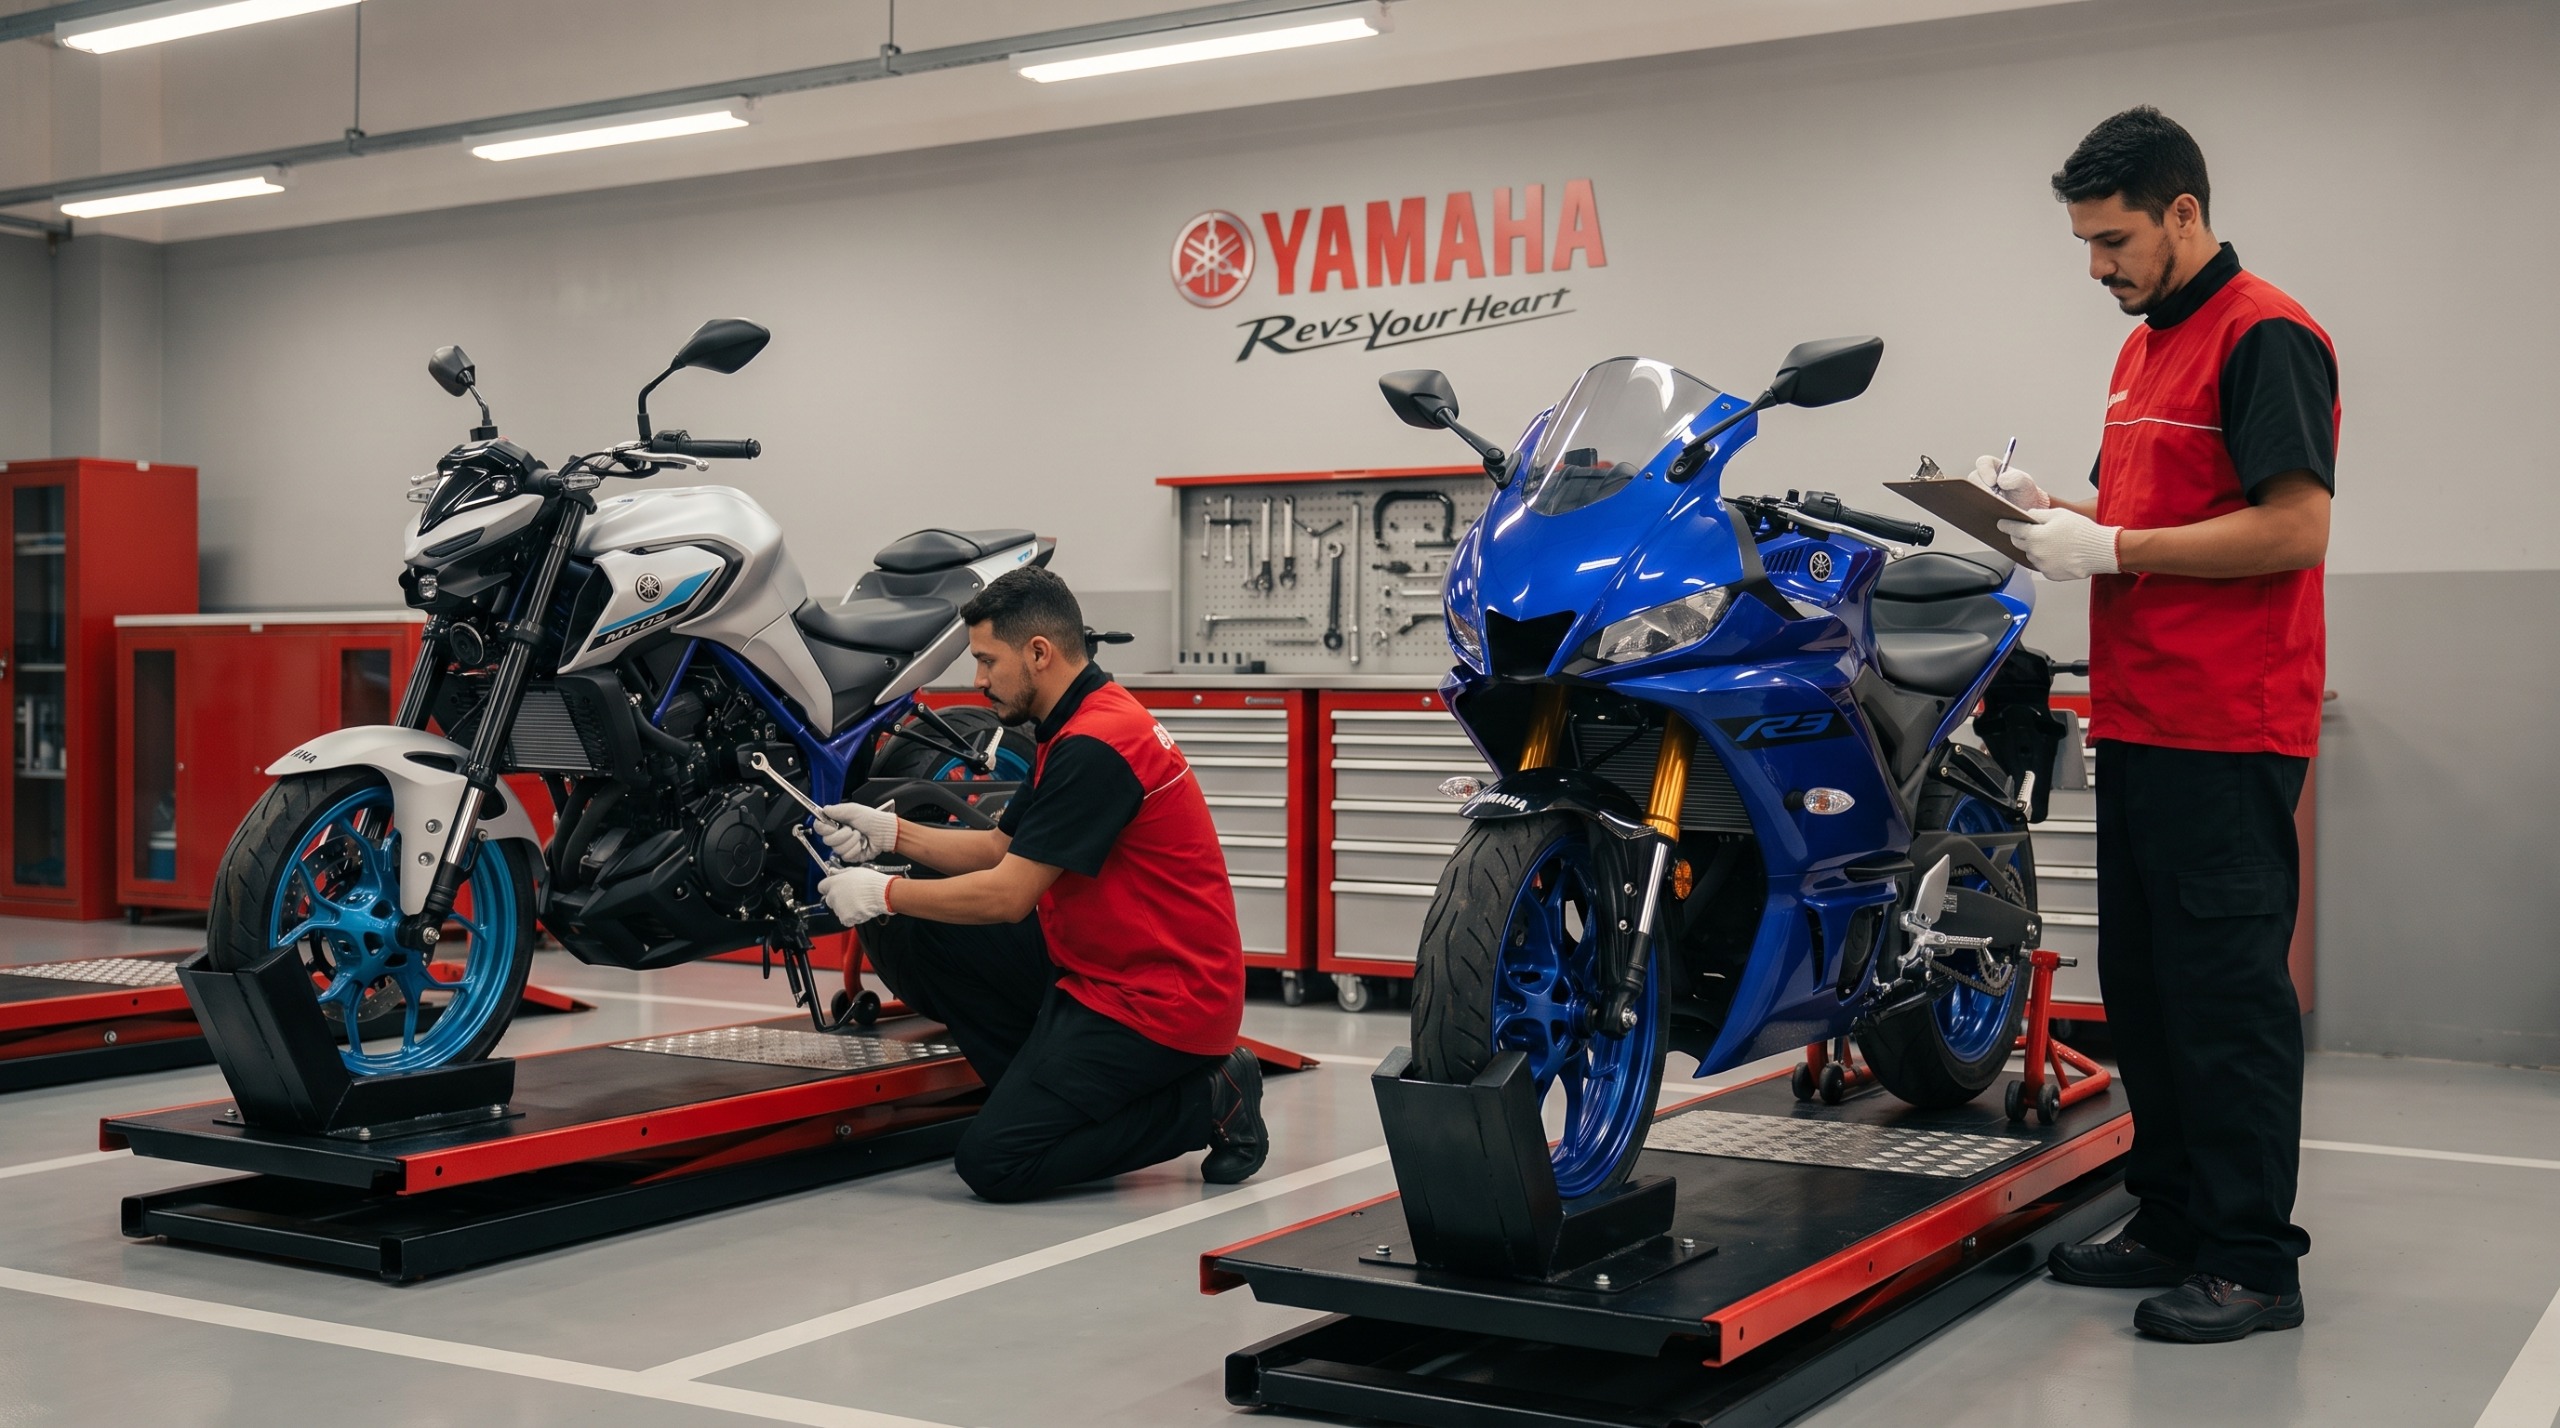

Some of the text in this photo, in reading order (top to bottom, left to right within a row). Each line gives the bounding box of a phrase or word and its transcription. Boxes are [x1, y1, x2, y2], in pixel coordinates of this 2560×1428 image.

[1262, 178, 1607, 296] YAMAHA
[1236, 287, 1572, 363] Revs Your Heart
[1735, 712, 1834, 742] R3
